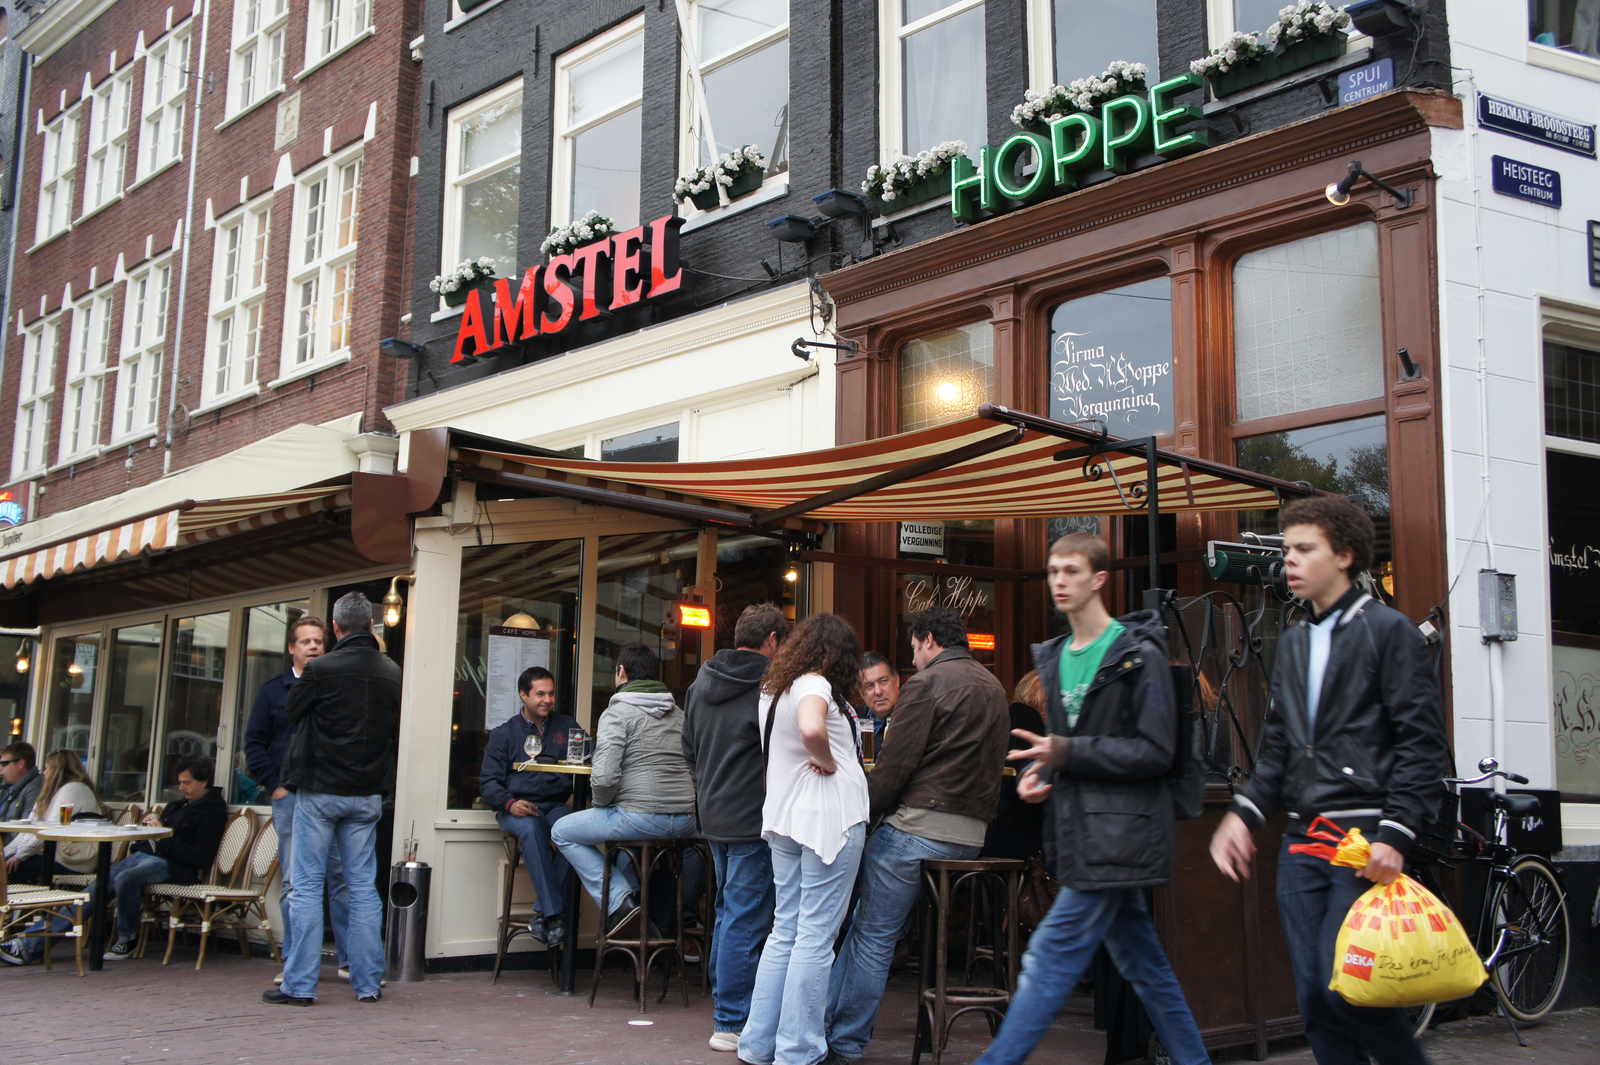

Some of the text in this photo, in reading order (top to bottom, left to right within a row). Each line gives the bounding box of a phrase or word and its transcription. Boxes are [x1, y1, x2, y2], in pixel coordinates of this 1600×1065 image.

[1349, 65, 1380, 88] SPUI
[1343, 81, 1388, 103] CENTRUM
[1487, 99, 1590, 142] HERMAN-BROODSTEEG
[951, 75, 1200, 222] HOPPE
[1502, 161, 1552, 188] HEISTEEG
[1518, 184, 1553, 201] CENTRUM
[449, 214, 684, 364] AMSTEL
[903, 524, 943, 536] VOLLEDIGE
[902, 536, 943, 548] VERGUNNING
[942, 576, 989, 618] Hoppe
[1344, 953, 1374, 967] DEKA
